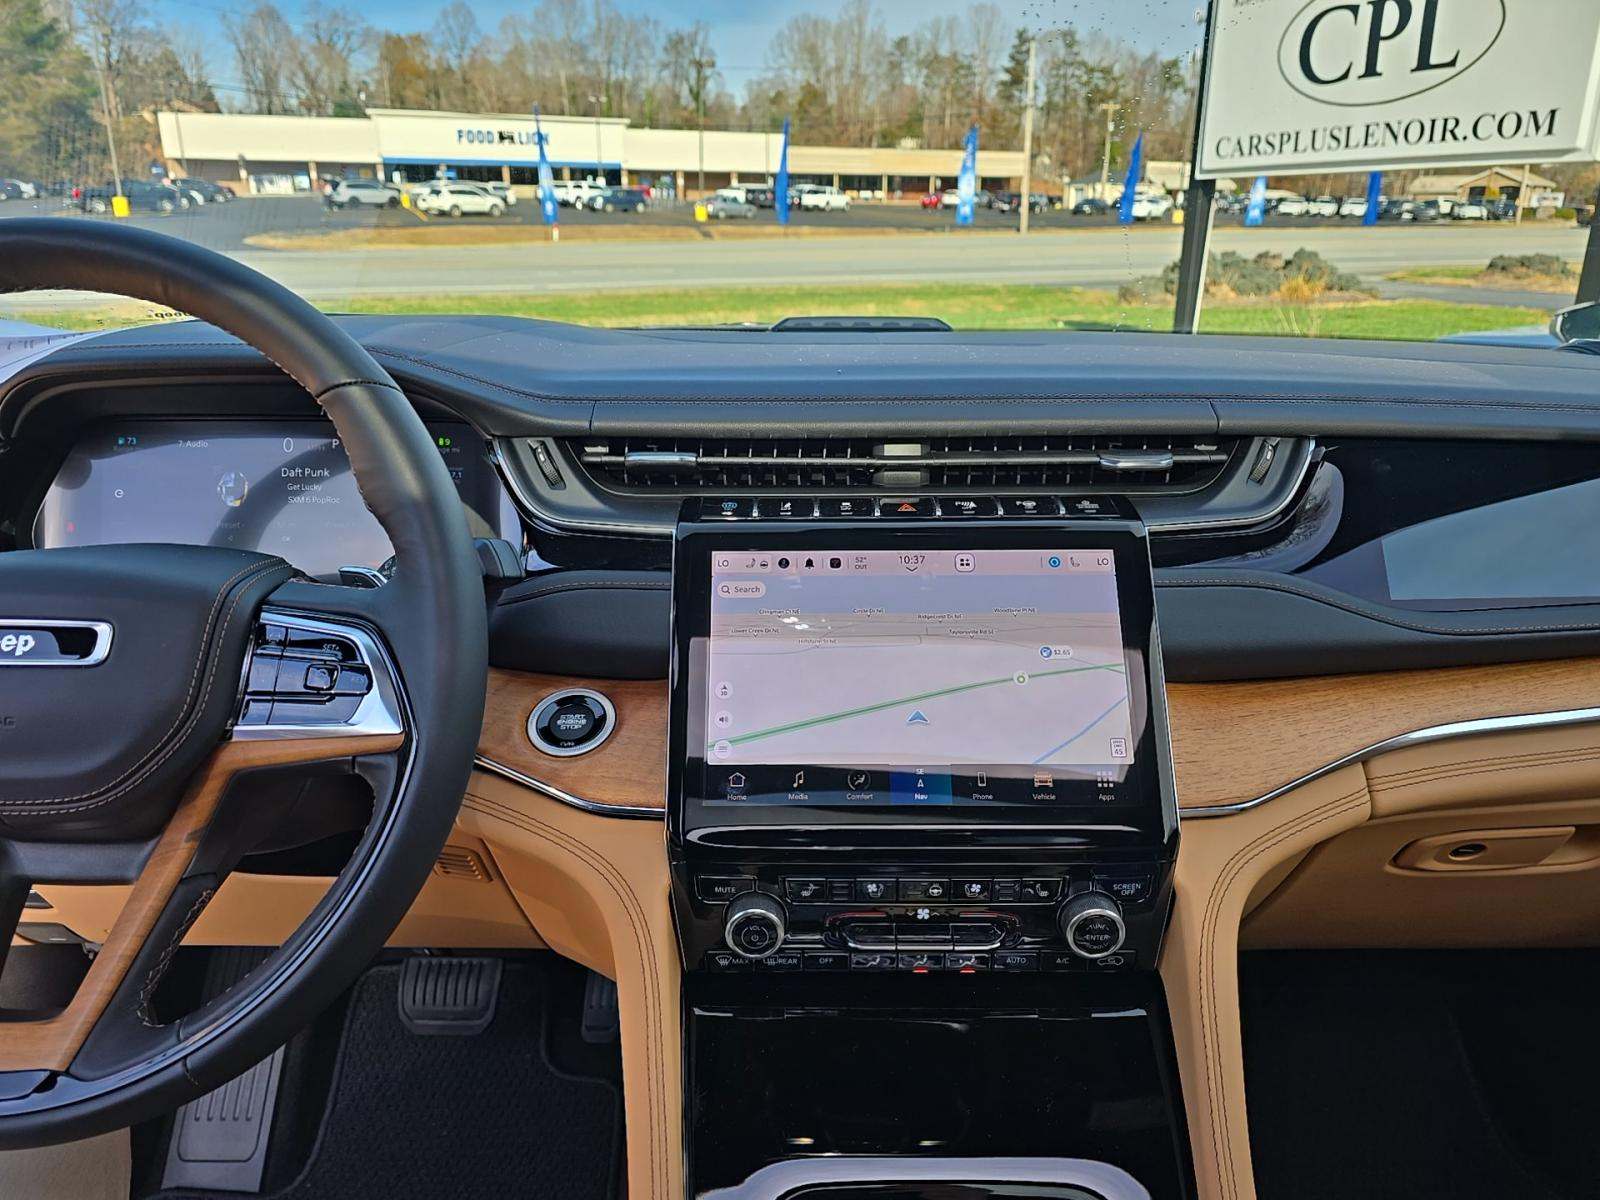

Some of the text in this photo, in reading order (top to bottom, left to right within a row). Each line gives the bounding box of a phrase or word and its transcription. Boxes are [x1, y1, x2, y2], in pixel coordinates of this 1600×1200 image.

[1299, 0, 1461, 85] CPL
[457, 129, 494, 143] FOOD
[1215, 107, 1560, 160] CARSPLUSLENOIR.COM
[332, 439, 339, 448] P
[281, 467, 330, 477] Daft Punk
[287, 483, 322, 492] Get Lucky
[717, 559, 729, 567] LO
[899, 555, 925, 565] 10:37
[1097, 558, 1109, 566] LO
[734, 585, 760, 593] Search
[1098, 793, 1115, 802] Apps
